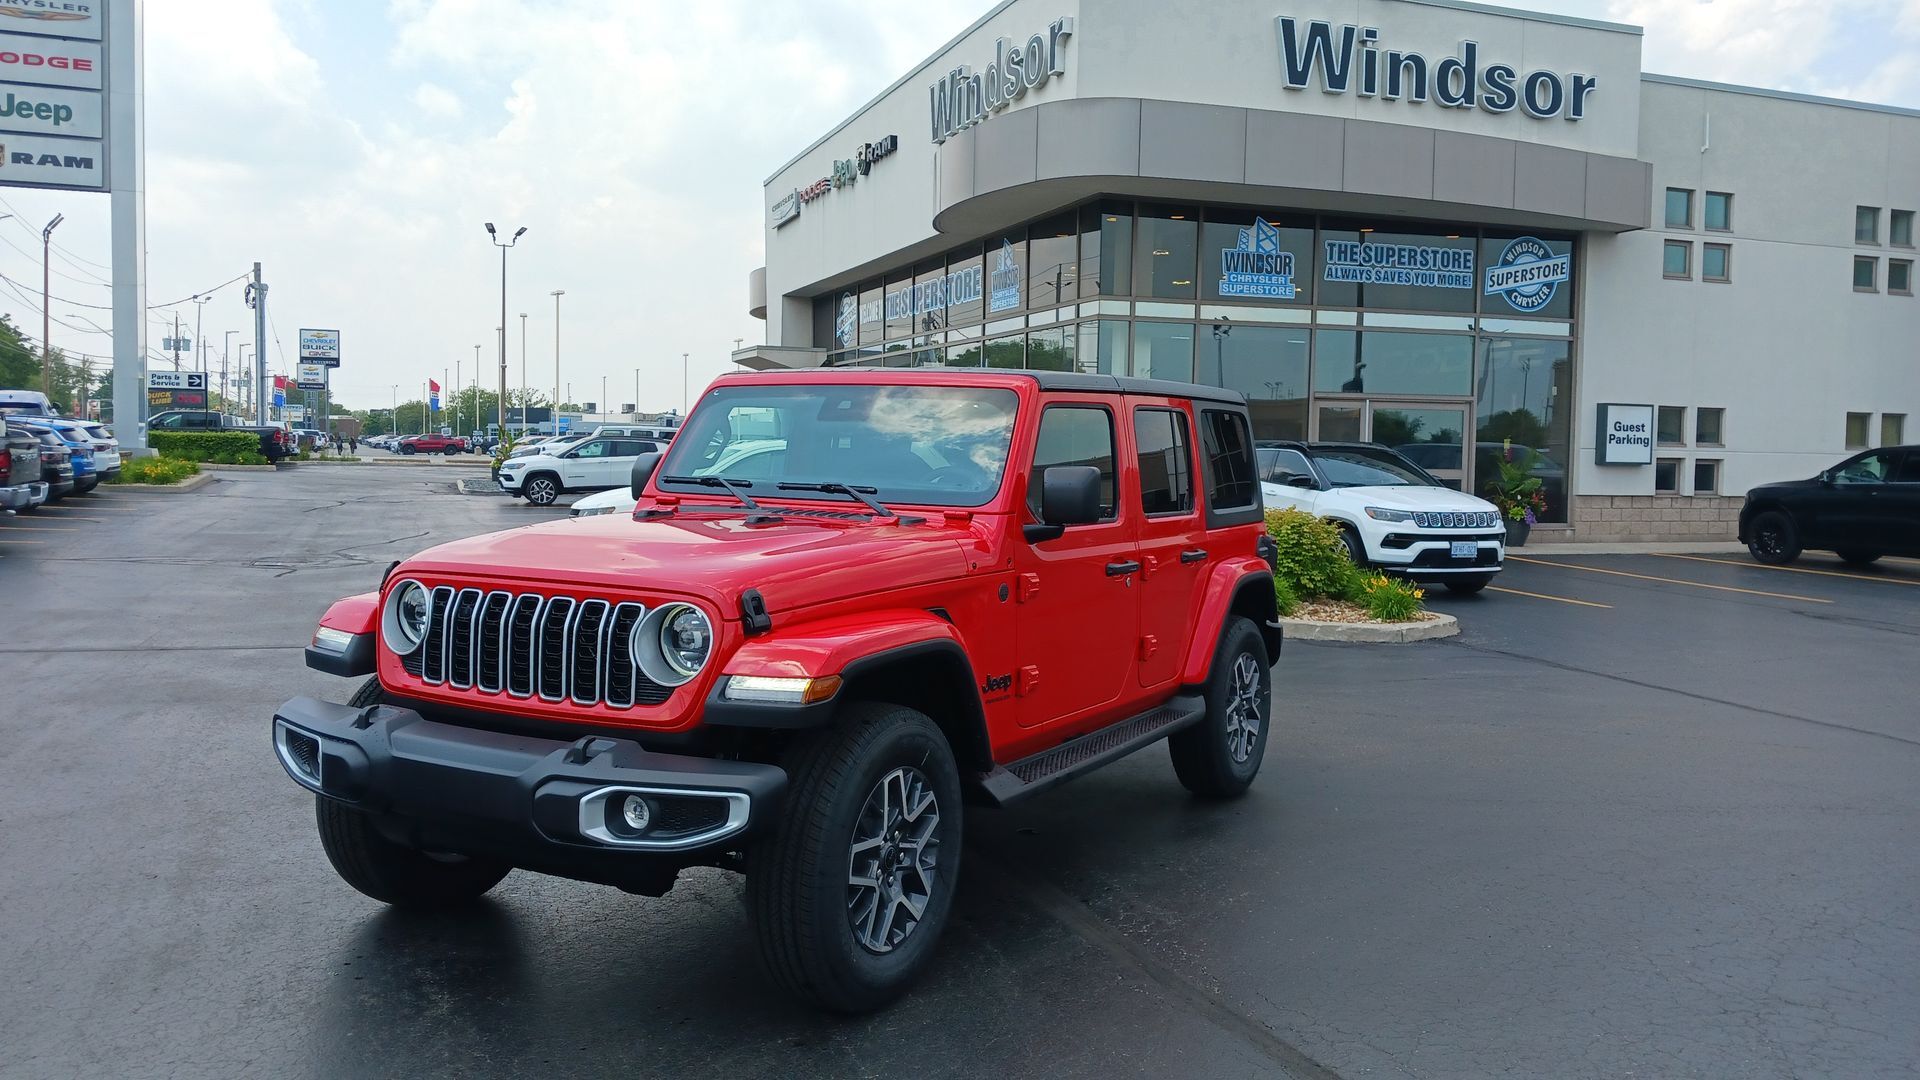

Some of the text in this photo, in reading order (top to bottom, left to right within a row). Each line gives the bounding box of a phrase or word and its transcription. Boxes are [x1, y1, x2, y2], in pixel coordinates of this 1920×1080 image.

[0, 0, 90, 12] RYSLER
[1275, 16, 1597, 121] Windsor
[929, 16, 1073, 144] Windsor
[0, 93, 72, 126] Jeep
[866, 135, 898, 163] RAM
[11, 152, 94, 169] RAM
[800, 177, 831, 204] DODGE
[1326, 242, 1473, 270] THE SUPERSTORE
[1505, 242, 1545, 262] WINDSOR
[1224, 251, 1292, 275] WINDSOR
[1230, 274, 1286, 284] CHRYSLER
[1326, 266, 1472, 286] ALWAYS SAVES YOU MORE!
[1489, 262, 1566, 288] SUPERSTORE
[886, 293, 899, 319] THE
[901, 266, 982, 318] SUPERSTORE
[1222, 283, 1293, 295] SUPERSTORE
[1511, 286, 1550, 307] CHRYSLER
[1613, 421, 1645, 432] Guest
[1608, 434, 1650, 447] Parking
[982, 674, 1012, 694] Jeep
